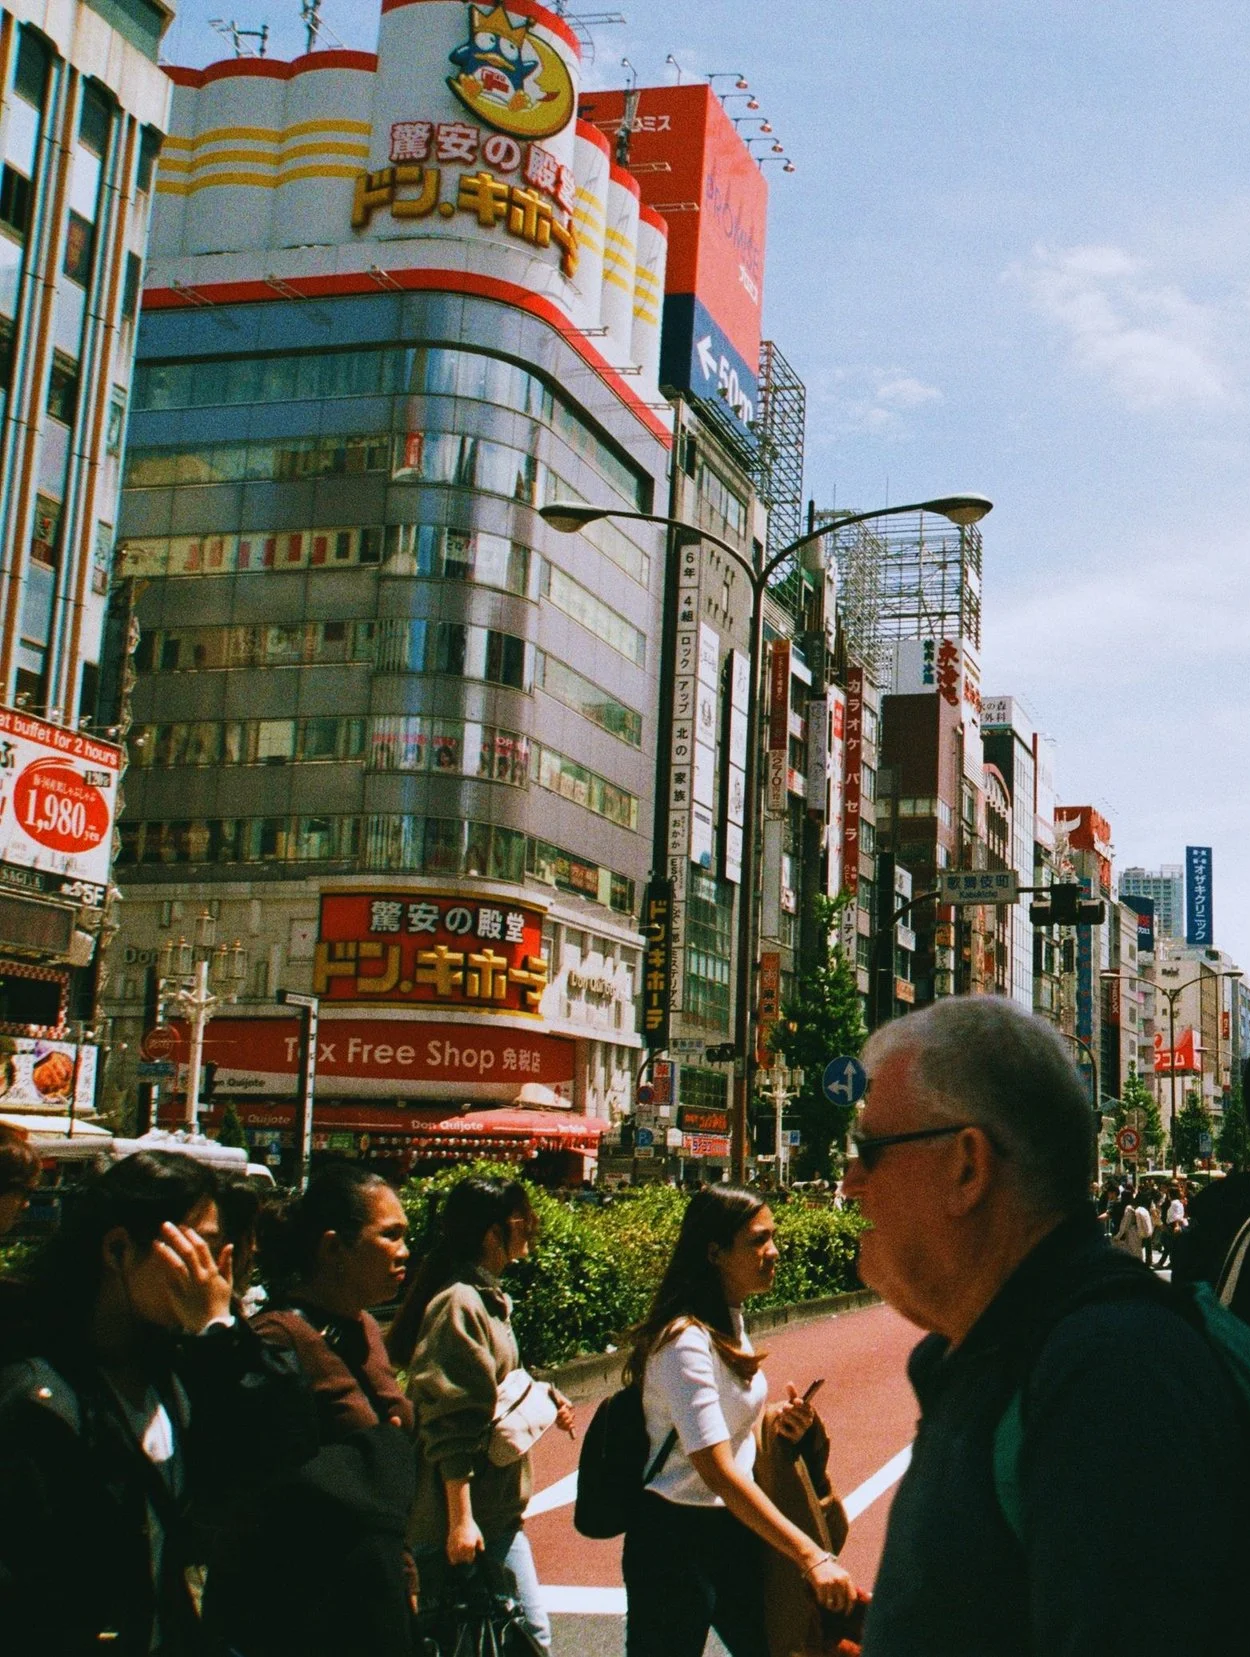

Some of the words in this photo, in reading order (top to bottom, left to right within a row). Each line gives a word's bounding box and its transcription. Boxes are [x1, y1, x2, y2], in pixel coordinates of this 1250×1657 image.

[846, 680, 861, 750] カラオケ
[14, 715, 50, 744] buffet
[54, 730, 70, 749] for
[74, 738, 82, 753] 2
[85, 742, 118, 766] hours
[673, 728, 689, 803] 北の家族
[24, 789, 86, 840] 1,980
[84, 829, 100, 843] yen
[845, 772, 859, 841] パセラ
[82, 883, 104, 905] 5F
[947, 874, 1009, 890] 歌舞伎町
[1194, 865, 1207, 940] オザキクリニック
[370, 901, 525, 943] 驚安の殿堂
[284, 1037, 337, 1063] Tx
[348, 1037, 415, 1065] Free
[427, 1039, 495, 1074] Shop
[502, 1047, 541, 1073] 免税店
[247, 1113, 291, 1125] Quijote
[411, 1119, 436, 1129] Don
[439, 1120, 484, 1132] Quijote
